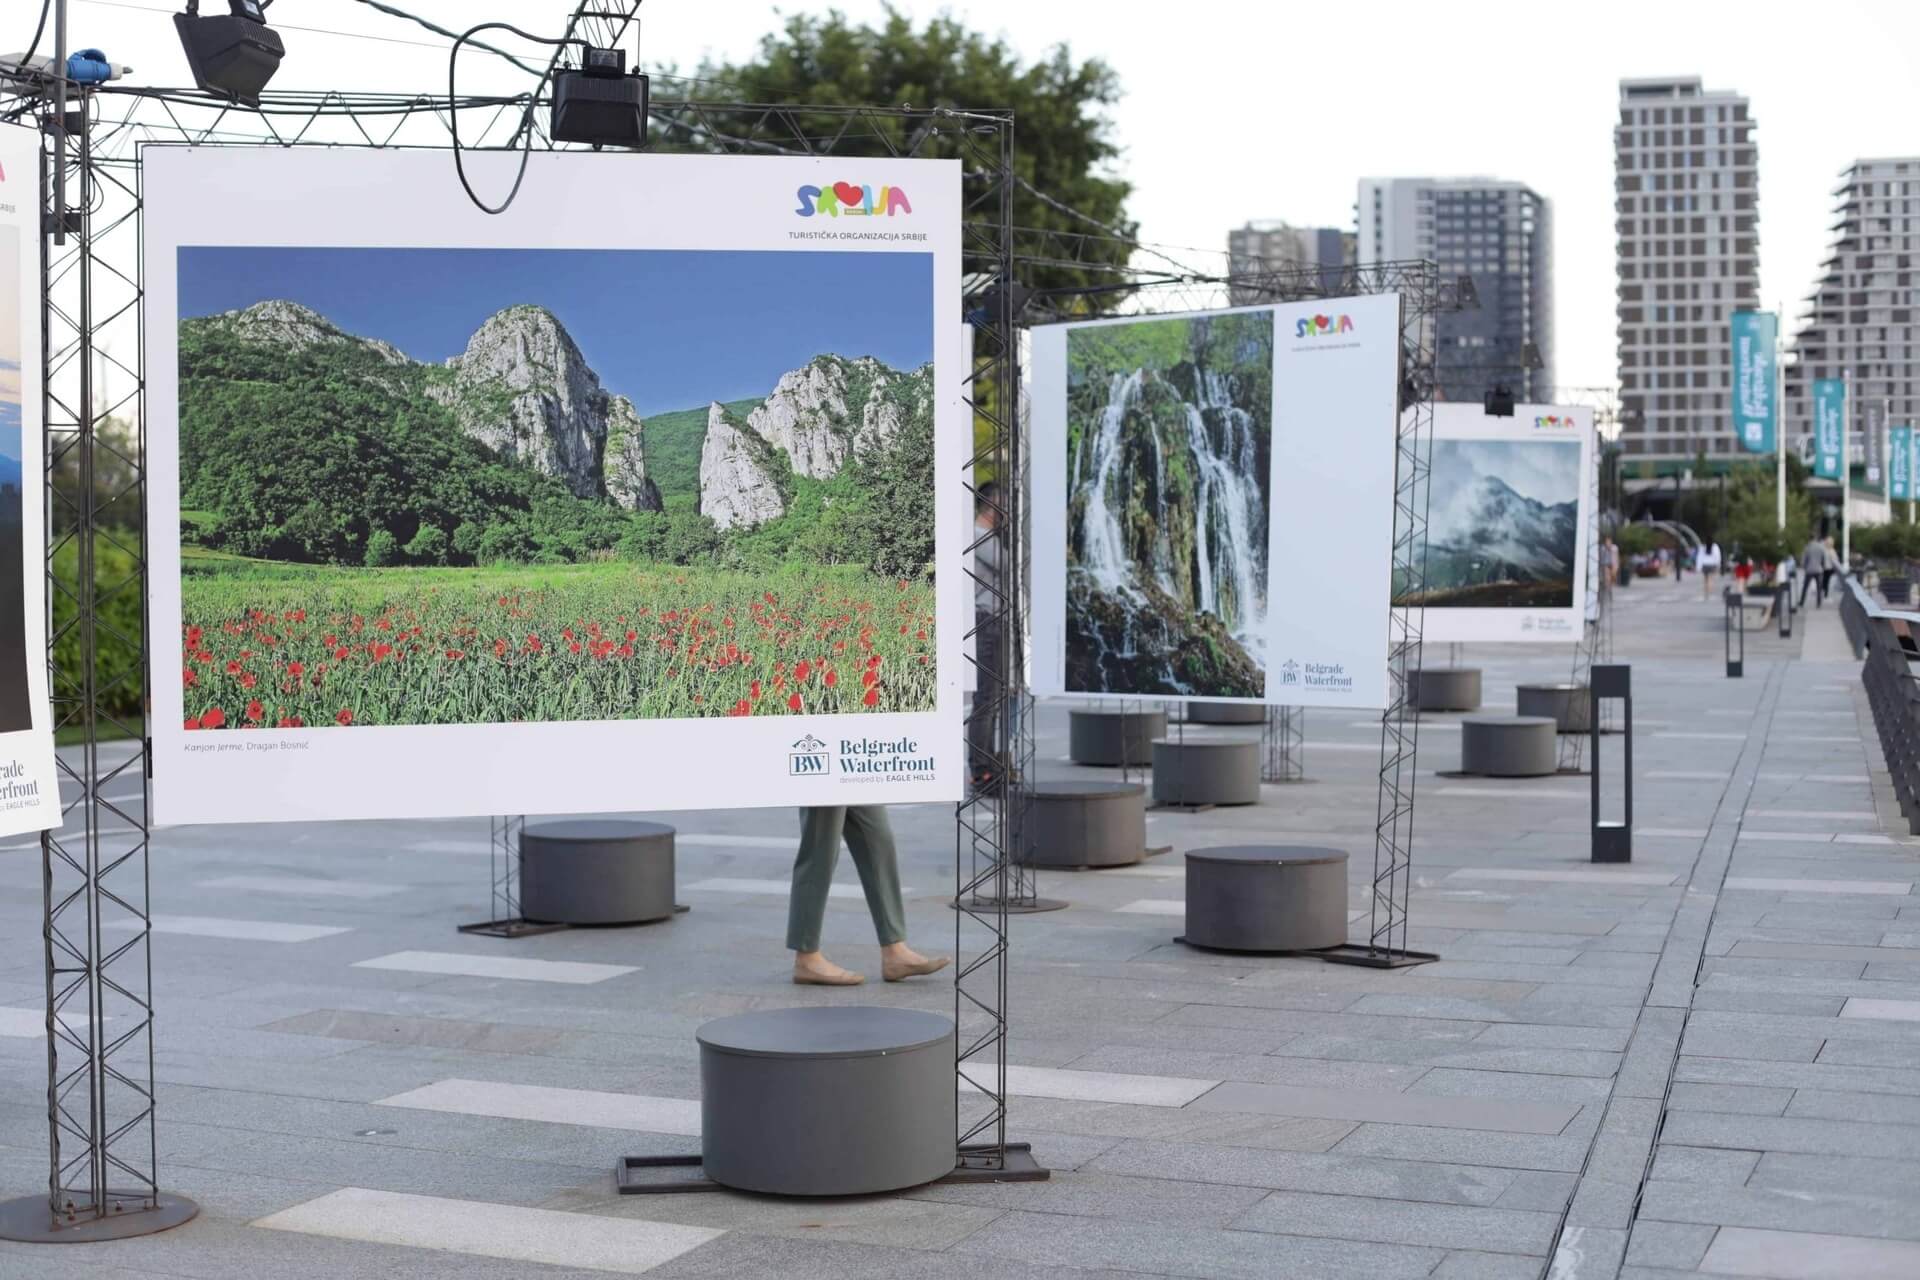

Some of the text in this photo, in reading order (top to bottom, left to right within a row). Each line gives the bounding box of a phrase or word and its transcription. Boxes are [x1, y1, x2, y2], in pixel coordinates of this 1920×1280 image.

[788, 231, 928, 242] TURISTIČKA ORGANIZACIJA SRBIJE
[1305, 663, 1344, 674] Belgrade
[1305, 674, 1352, 686] Waterfront
[183, 743, 215, 753] Kanjon
[246, 742, 278, 752] Dragan
[840, 737, 917, 757] Belgrade
[794, 755, 826, 773] BW
[840, 756, 936, 773] Waterfront
[886, 774, 911, 782] EAGLE
[913, 773, 936, 781] HILLS
